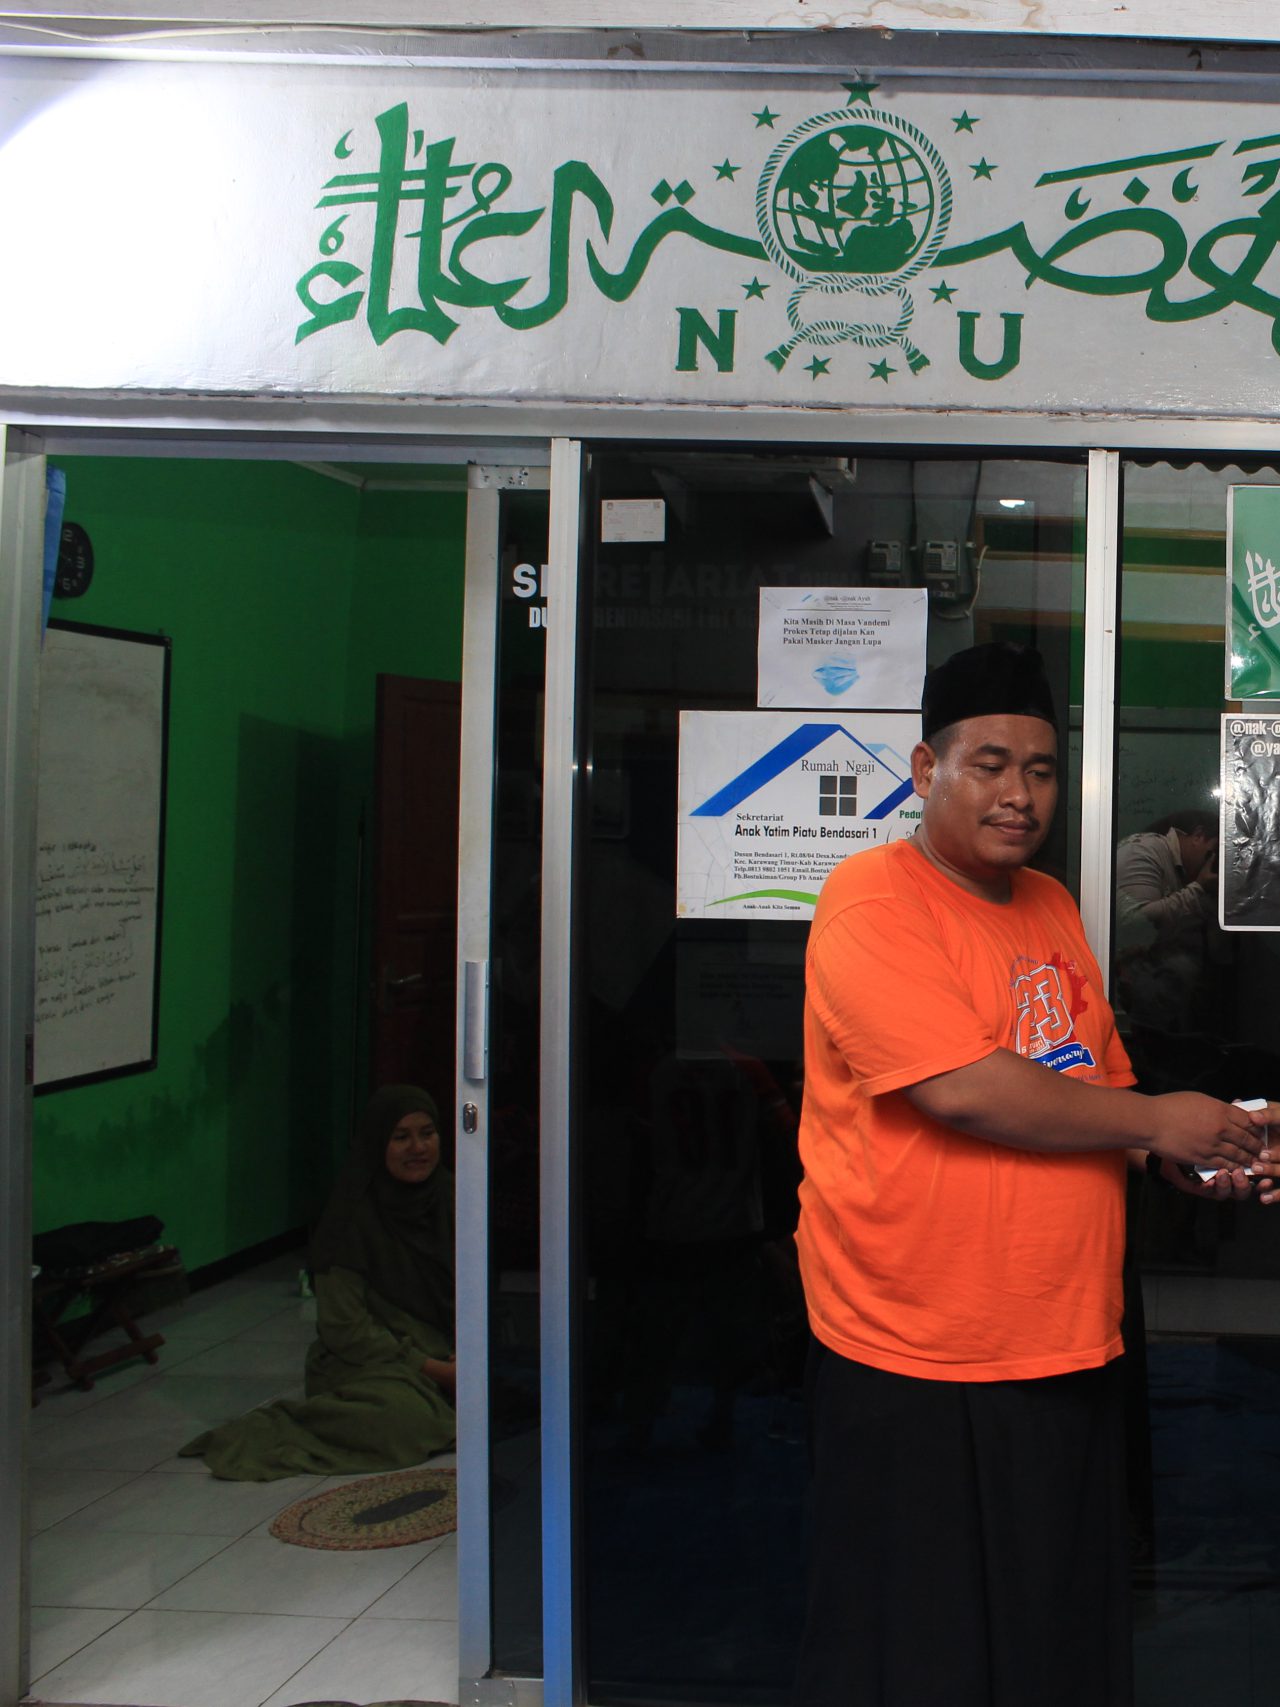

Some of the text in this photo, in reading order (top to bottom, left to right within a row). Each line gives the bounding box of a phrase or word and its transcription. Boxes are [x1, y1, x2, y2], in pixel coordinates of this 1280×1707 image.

[676, 307, 1025, 380] N U
[783, 618, 799, 626] Kita
[801, 618, 824, 626] Masih
[783, 628, 808, 636] Prokes
[810, 628, 831, 637] Tetap
[833, 628, 858, 637] dijalan
[783, 637, 882, 647] Pakai Masker Jangan Lupa
[801, 759, 875, 775] Rumah Ngaji
[736, 813, 784, 822] Sekretariat
[735, 824, 877, 839] Anak Yatim Piatu Bendasari 1
